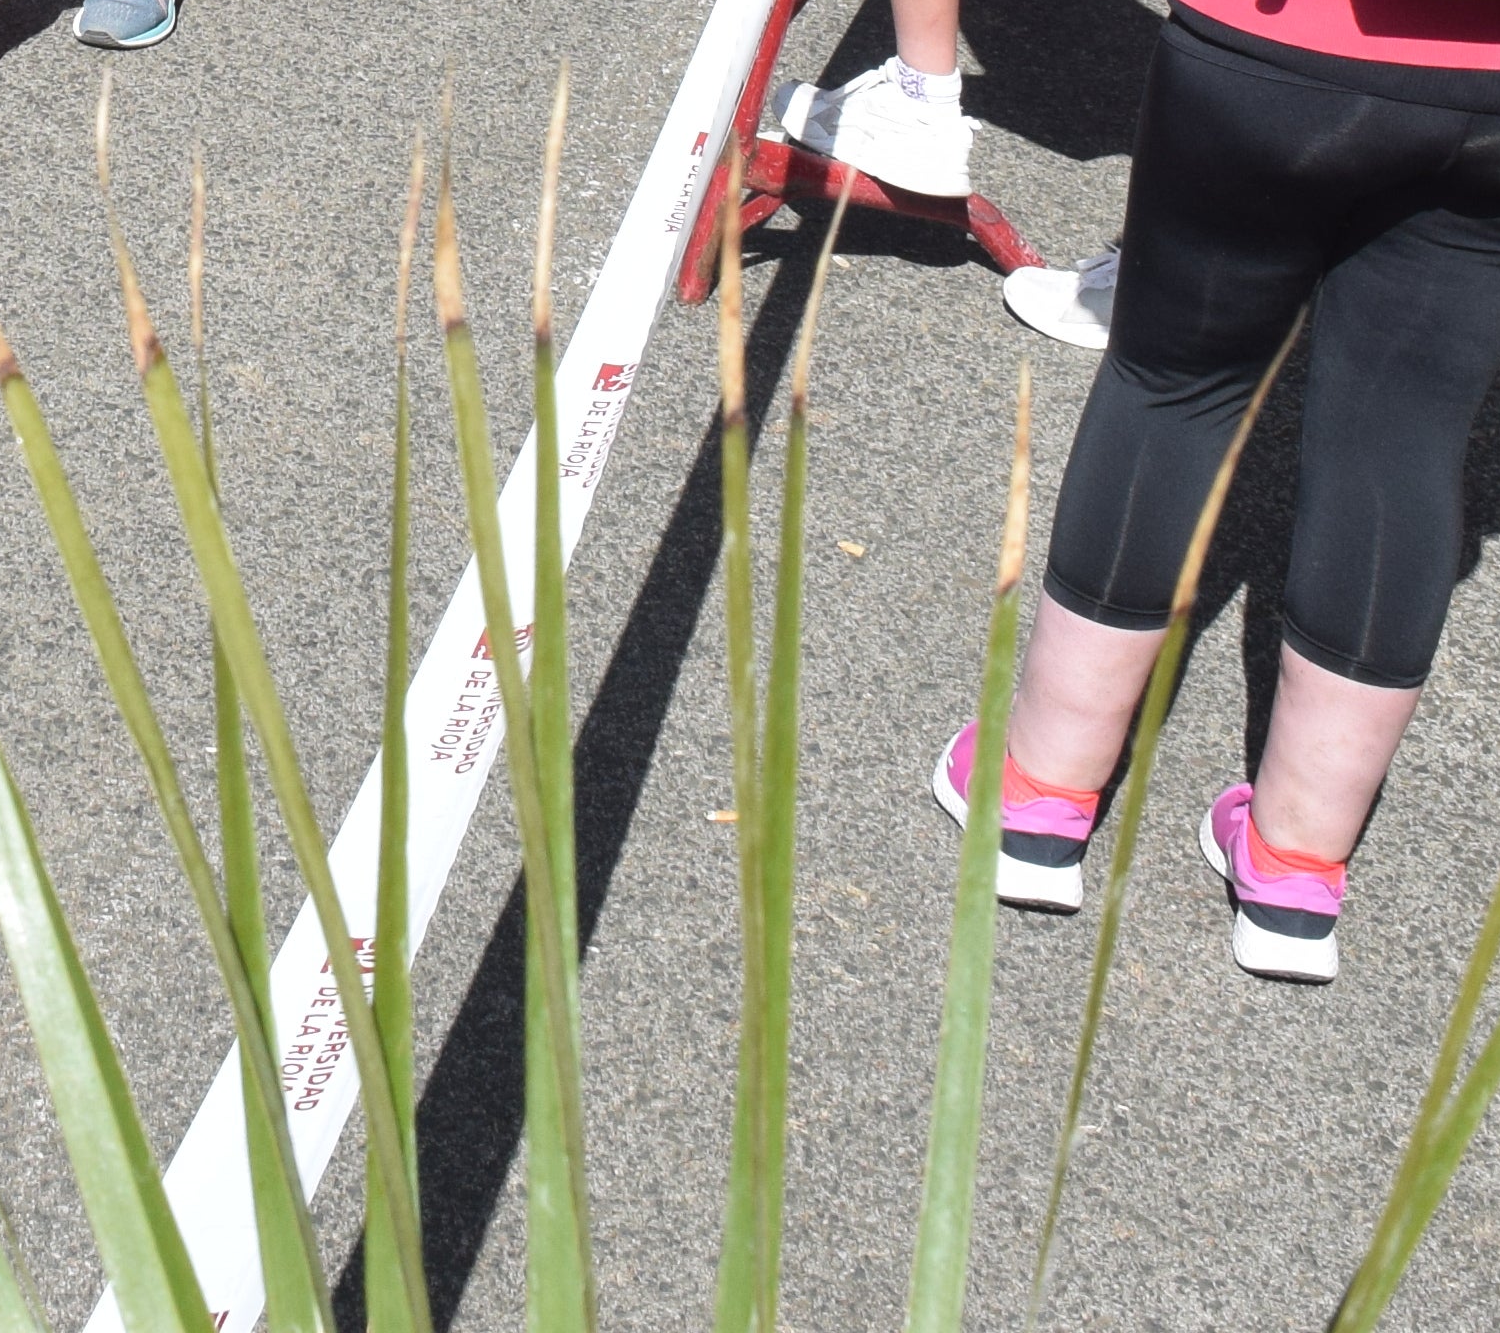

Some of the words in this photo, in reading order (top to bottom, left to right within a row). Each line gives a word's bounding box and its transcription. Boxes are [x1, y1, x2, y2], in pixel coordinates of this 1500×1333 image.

[587, 400, 612, 418] DE
[578, 421, 602, 438] LA
[559, 441, 593, 478] RIOJA
[465, 670, 492, 689] DE
[453, 694, 481, 713] LA
[430, 718, 470, 761] RIOJA
[310, 986, 339, 1008] DE
[296, 1013, 329, 1038] LA
